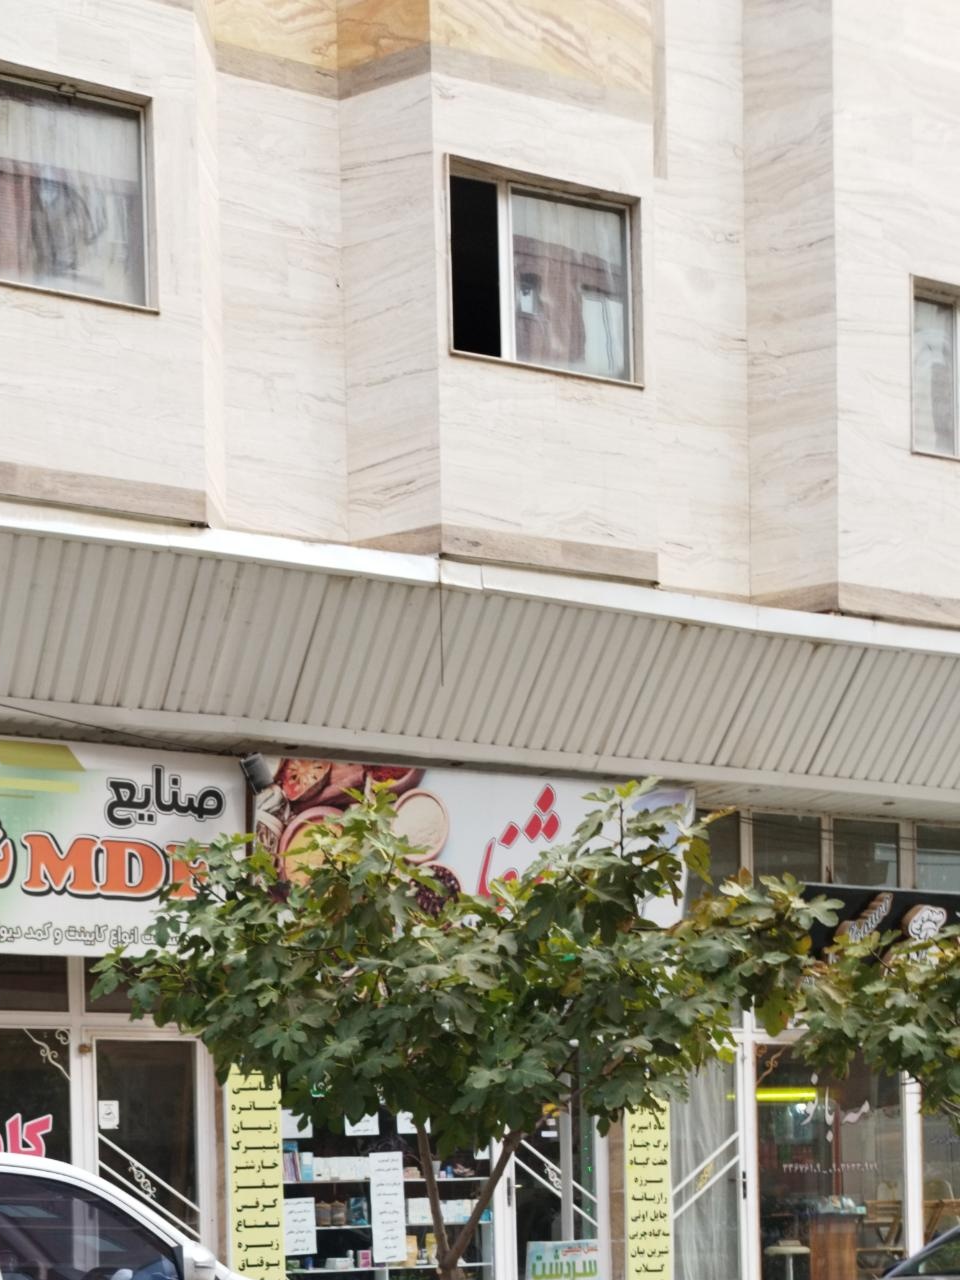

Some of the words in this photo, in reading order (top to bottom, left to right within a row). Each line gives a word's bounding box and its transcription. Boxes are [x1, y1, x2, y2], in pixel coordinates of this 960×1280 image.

[105, 765, 225, 828] صنایع
[24, 921, 52, 940] کمد
[53, 928, 63, 945] و
[65, 923, 108, 945] کابینت
[109, 925, 138, 949] انواع
[236, 1198, 278, 1213] کرفس
[235, 1217, 281, 1233] نعناع
[237, 1240, 280, 1252] زیره
